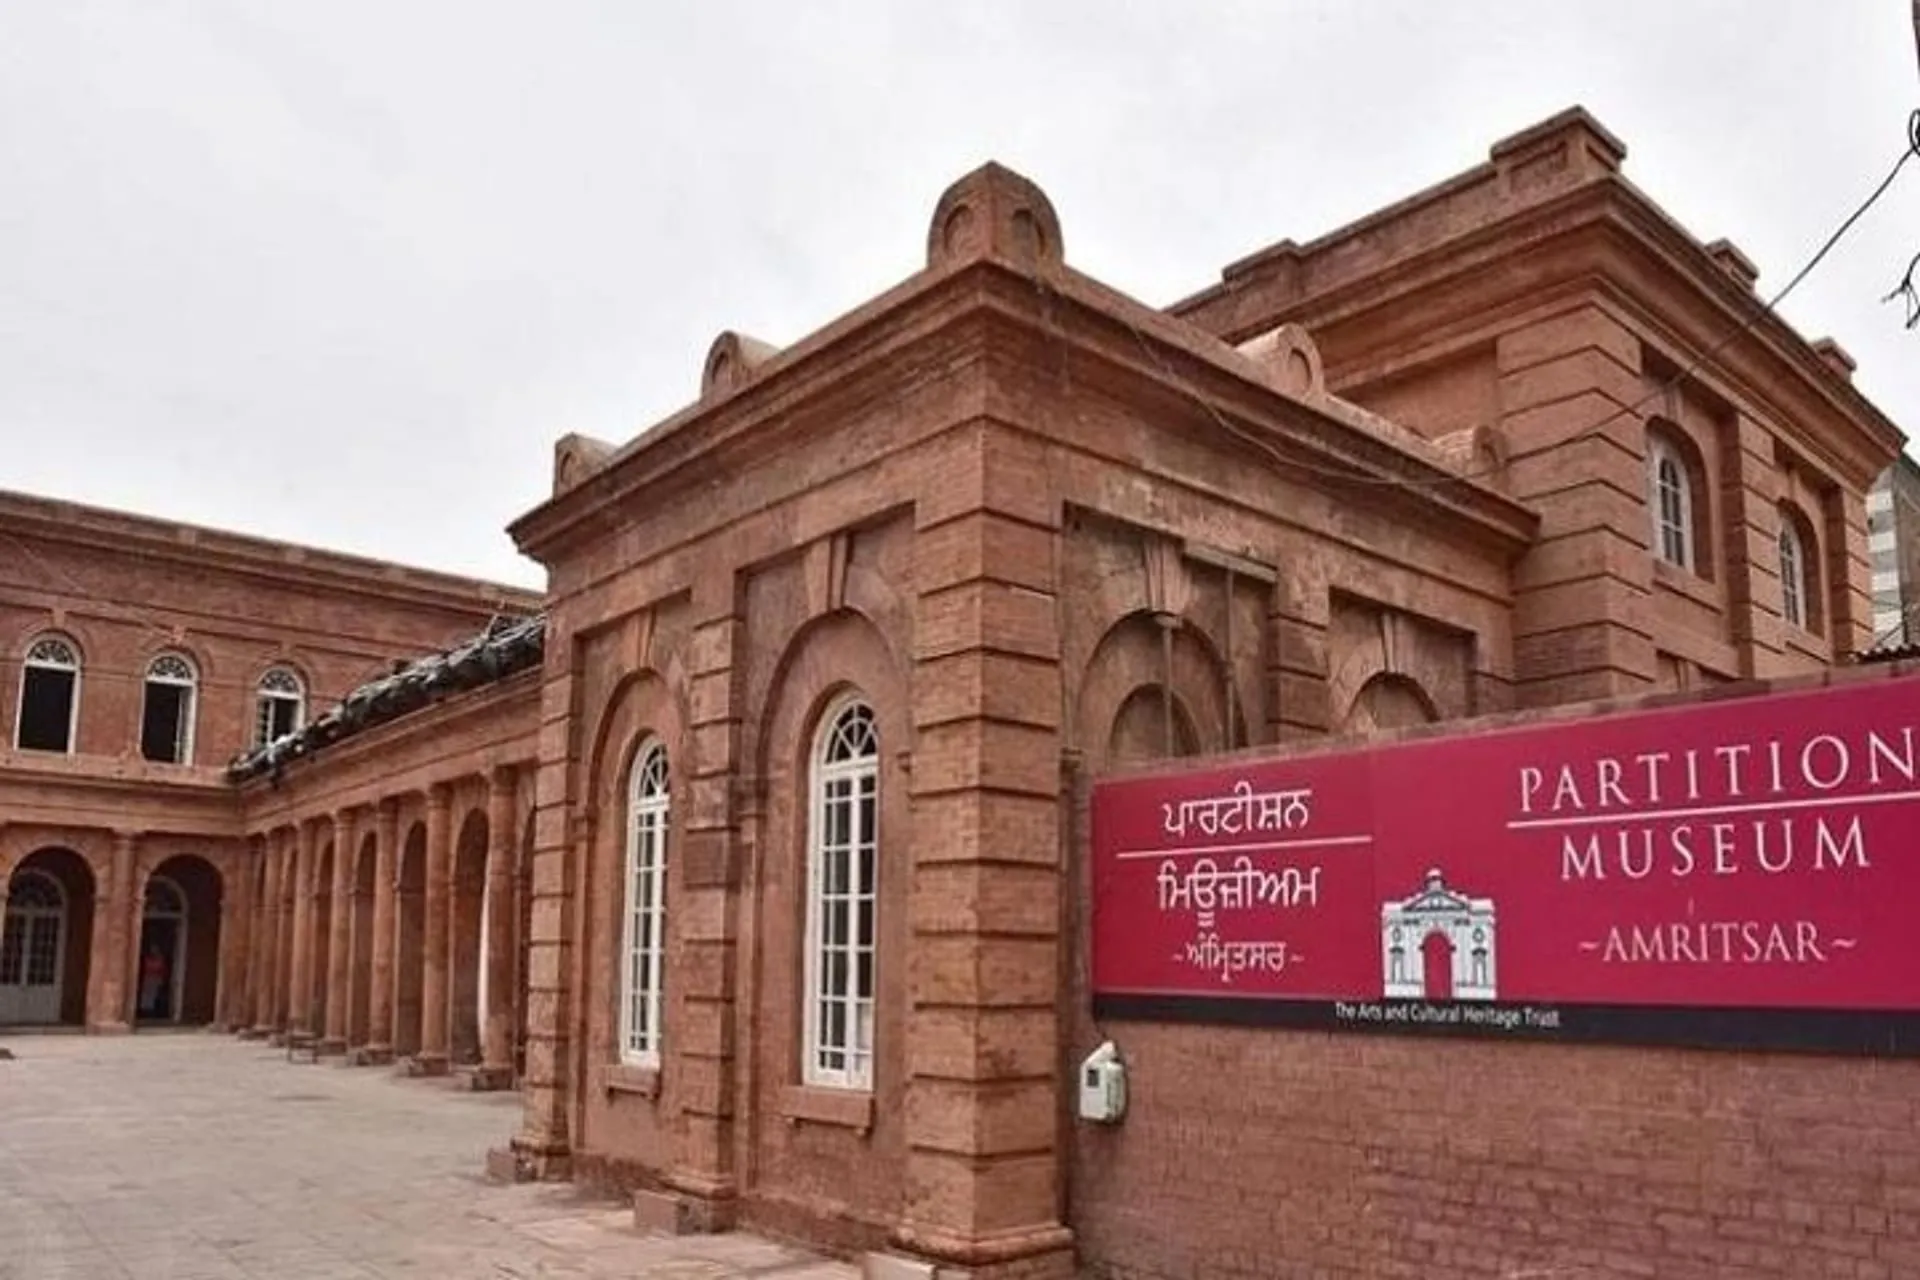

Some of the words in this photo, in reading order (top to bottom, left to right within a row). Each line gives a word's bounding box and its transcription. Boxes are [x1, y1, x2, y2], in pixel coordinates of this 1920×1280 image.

[1519, 726, 1914, 813] PARTITION
[1161, 780, 1313, 838] ਪਾਰਟੀਸ਼ਨ
[1561, 815, 1871, 881] MUSEUM
[1156, 855, 1322, 927] ਮਿਊਜ਼ੀਅਮ
[1335, 1002, 1356, 1019] The
[1358, 1003, 1382, 1020] Arts
[1384, 1003, 1408, 1020] and
[1410, 1004, 1460, 1023] Cultural
[1463, 1005, 1520, 1029] Heritage
